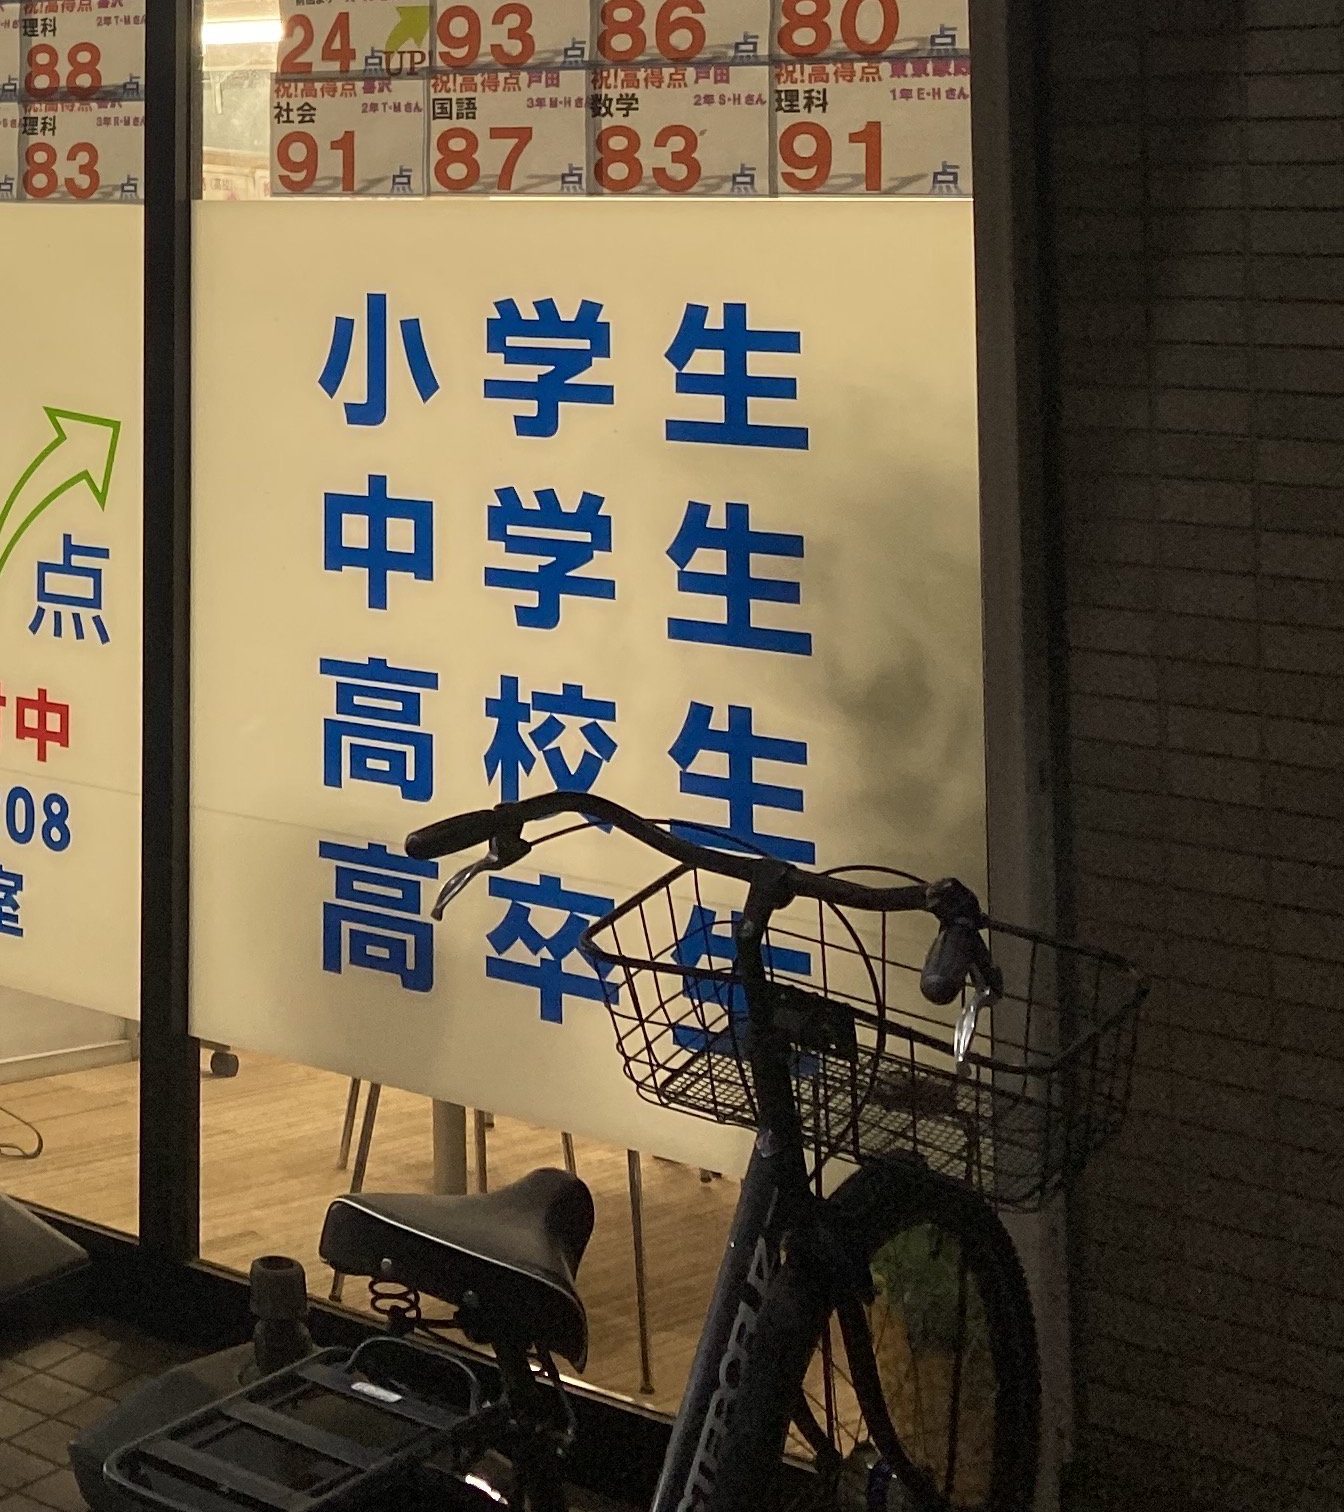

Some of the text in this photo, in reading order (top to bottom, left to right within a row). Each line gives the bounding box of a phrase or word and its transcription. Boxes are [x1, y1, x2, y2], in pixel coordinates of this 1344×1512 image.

[22, 17, 57, 37] 理科
[280, 12, 356, 75] 24
[436, 2, 536, 68] 93
[24, 42, 102, 100] 88
[774, 89, 829, 115] 理科
[22, 115, 56, 136] 理科
[273, 102, 317, 124] 社会
[432, 97, 477, 121] 国語
[591, 93, 639, 118] 数学
[23, 142, 100, 200] 83
[277, 130, 355, 192] 91
[434, 126, 533, 192] 87
[594, 125, 702, 193] 83
[779, 121, 882, 192] 91
[317, 291, 811, 451] 小学生
[26, 532, 112, 645] 点
[321, 473, 814, 656] 中学生
[317, 656, 817, 866] 高校生
